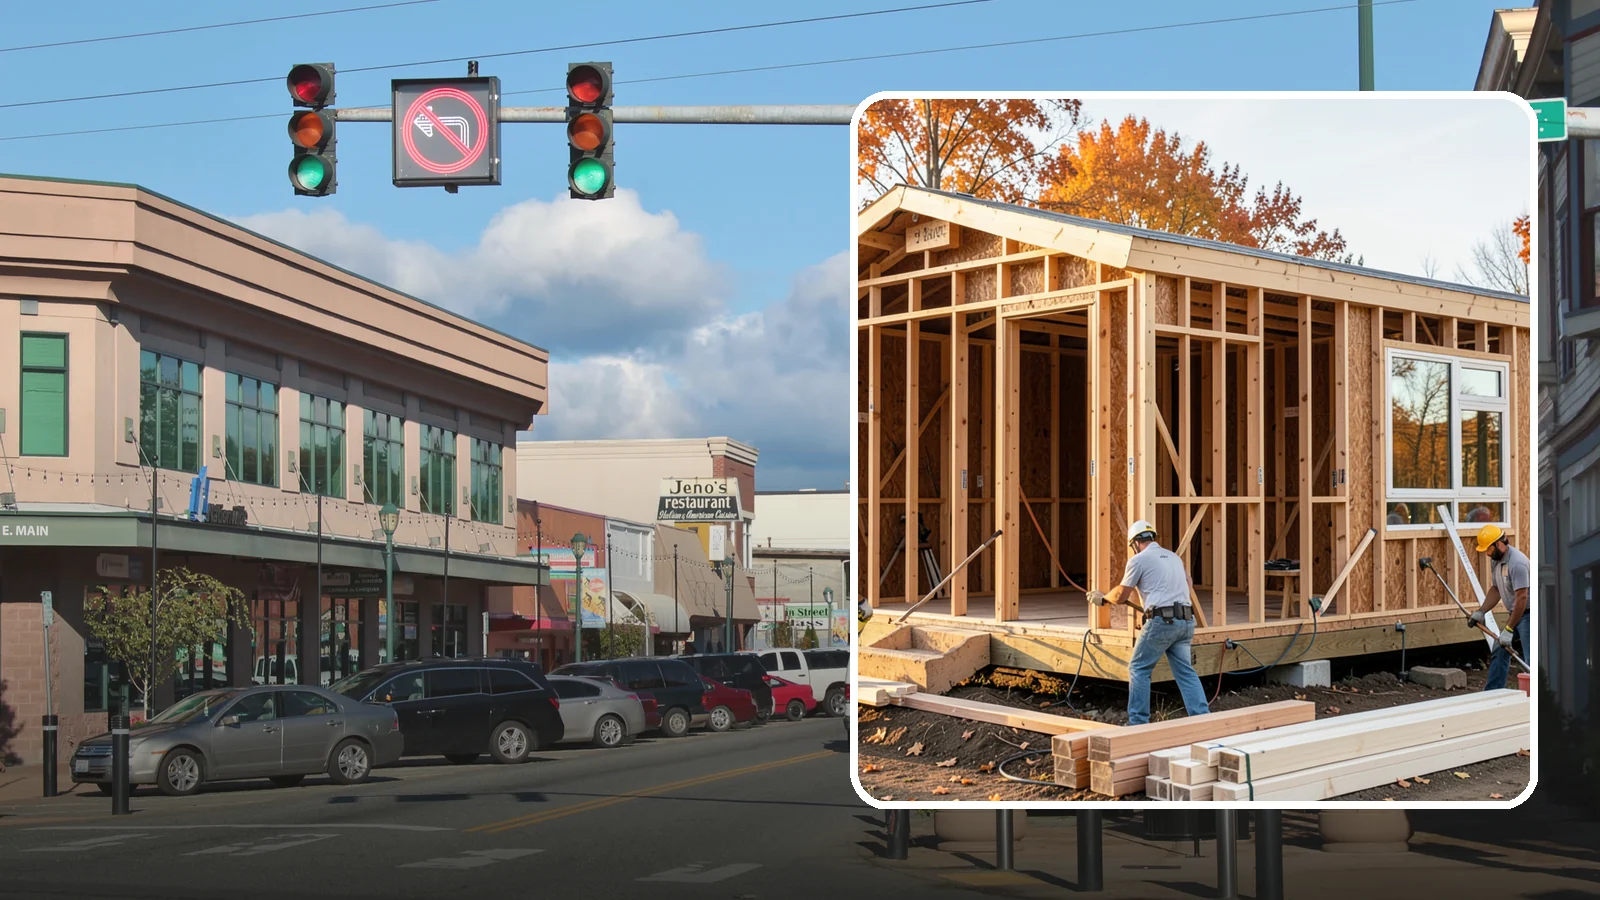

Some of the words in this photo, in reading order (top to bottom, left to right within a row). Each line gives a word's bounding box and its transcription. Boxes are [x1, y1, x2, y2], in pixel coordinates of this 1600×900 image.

[670, 480, 727, 494] Jeno's
[665, 496, 731, 509] restaurant
[685, 510, 714, 519] American
[715, 510, 737, 519] Cuisine
[2, 525, 13, 536] E.
[15, 525, 49, 536] MAIN
[797, 607, 828, 617] Street
